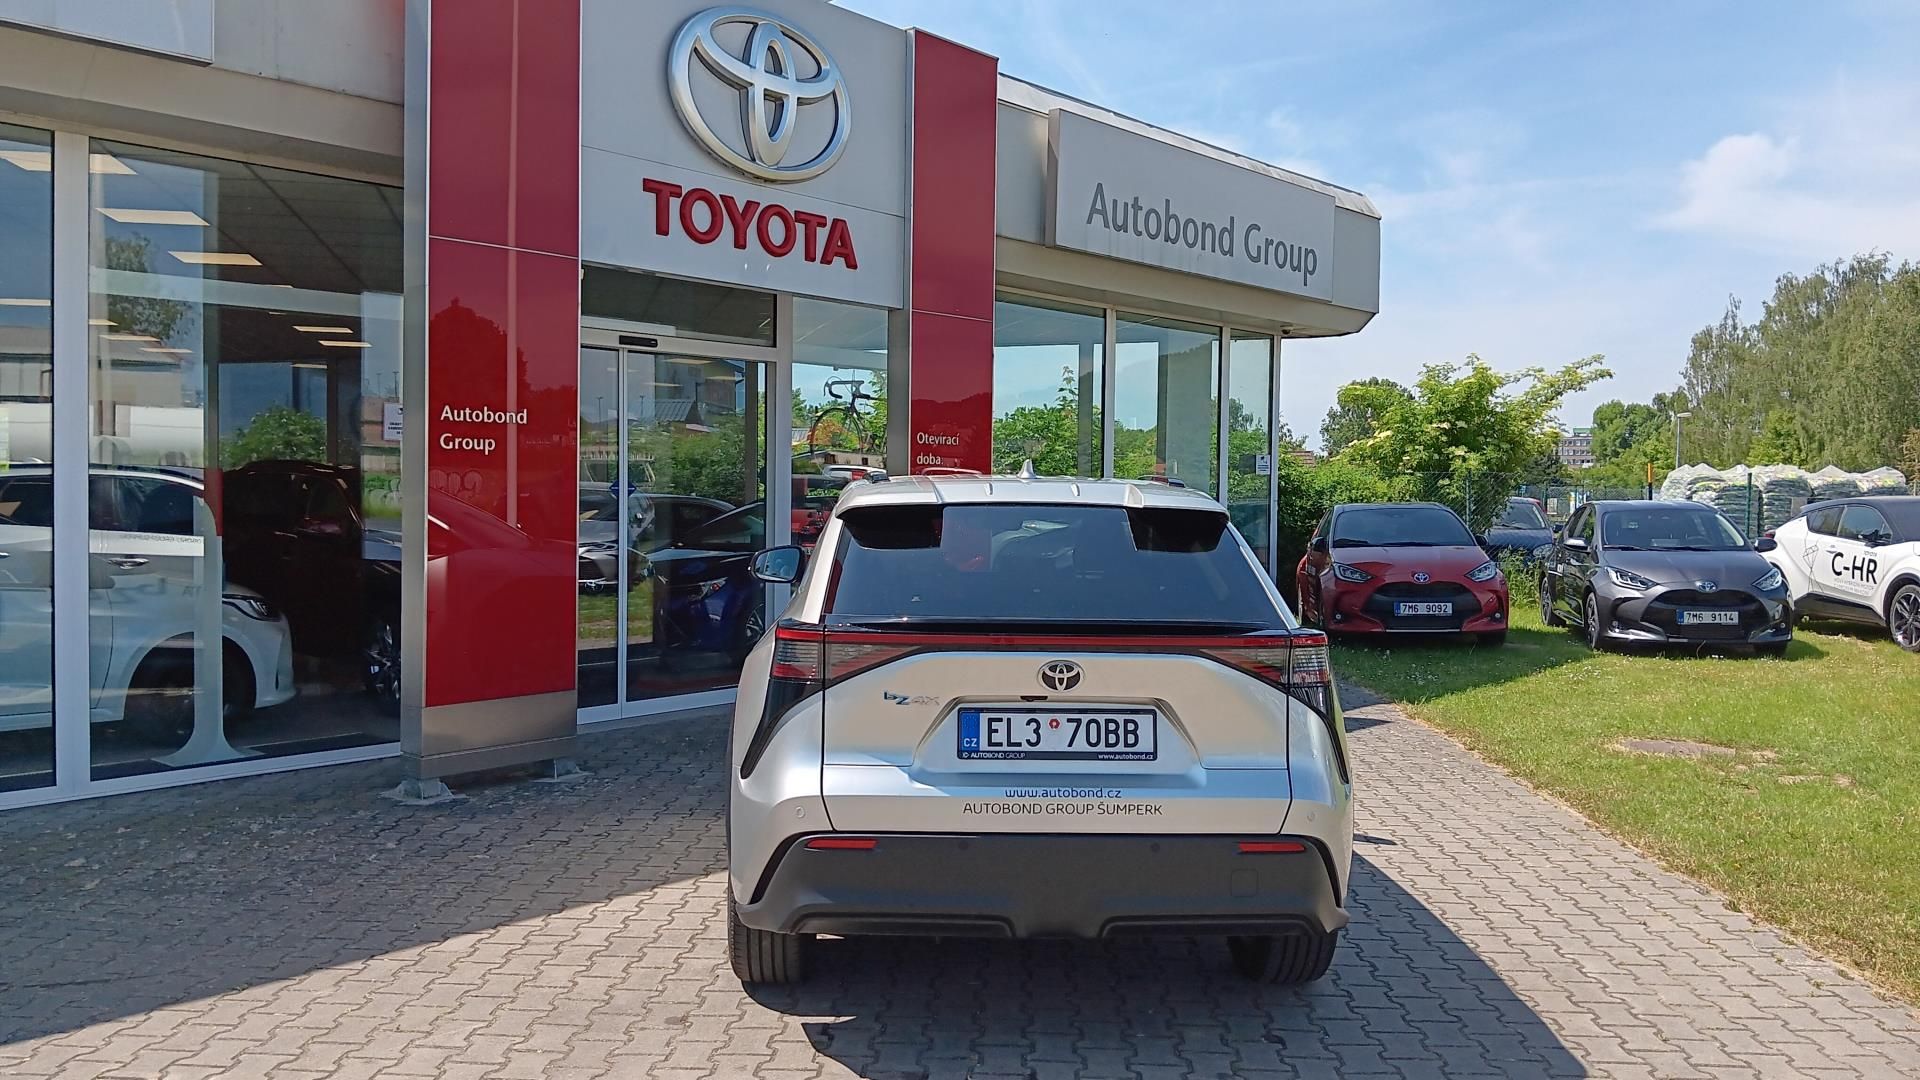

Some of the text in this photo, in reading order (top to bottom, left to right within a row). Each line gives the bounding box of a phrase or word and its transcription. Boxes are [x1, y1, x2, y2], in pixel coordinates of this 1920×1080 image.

[642, 177, 858, 270] TOYOTA
[1086, 182, 1318, 287] Autobond Group
[440, 404, 528, 425] Autobond
[439, 432, 496, 456] Group
[916, 431, 960, 446] Otevírací
[1831, 551, 1878, 585] C-HR
[1402, 604, 1419, 613] 7M6
[1425, 604, 1448, 613] 9092
[1686, 612, 1734, 622] 7M6 9114
[987, 717, 1139, 748] EL3 70BB
[963, 737, 977, 747] CZ
[1005, 787, 1122, 799] www.autobond.cz
[963, 800, 1163, 816] AUTOBOND GROUP ŠUMPERK
